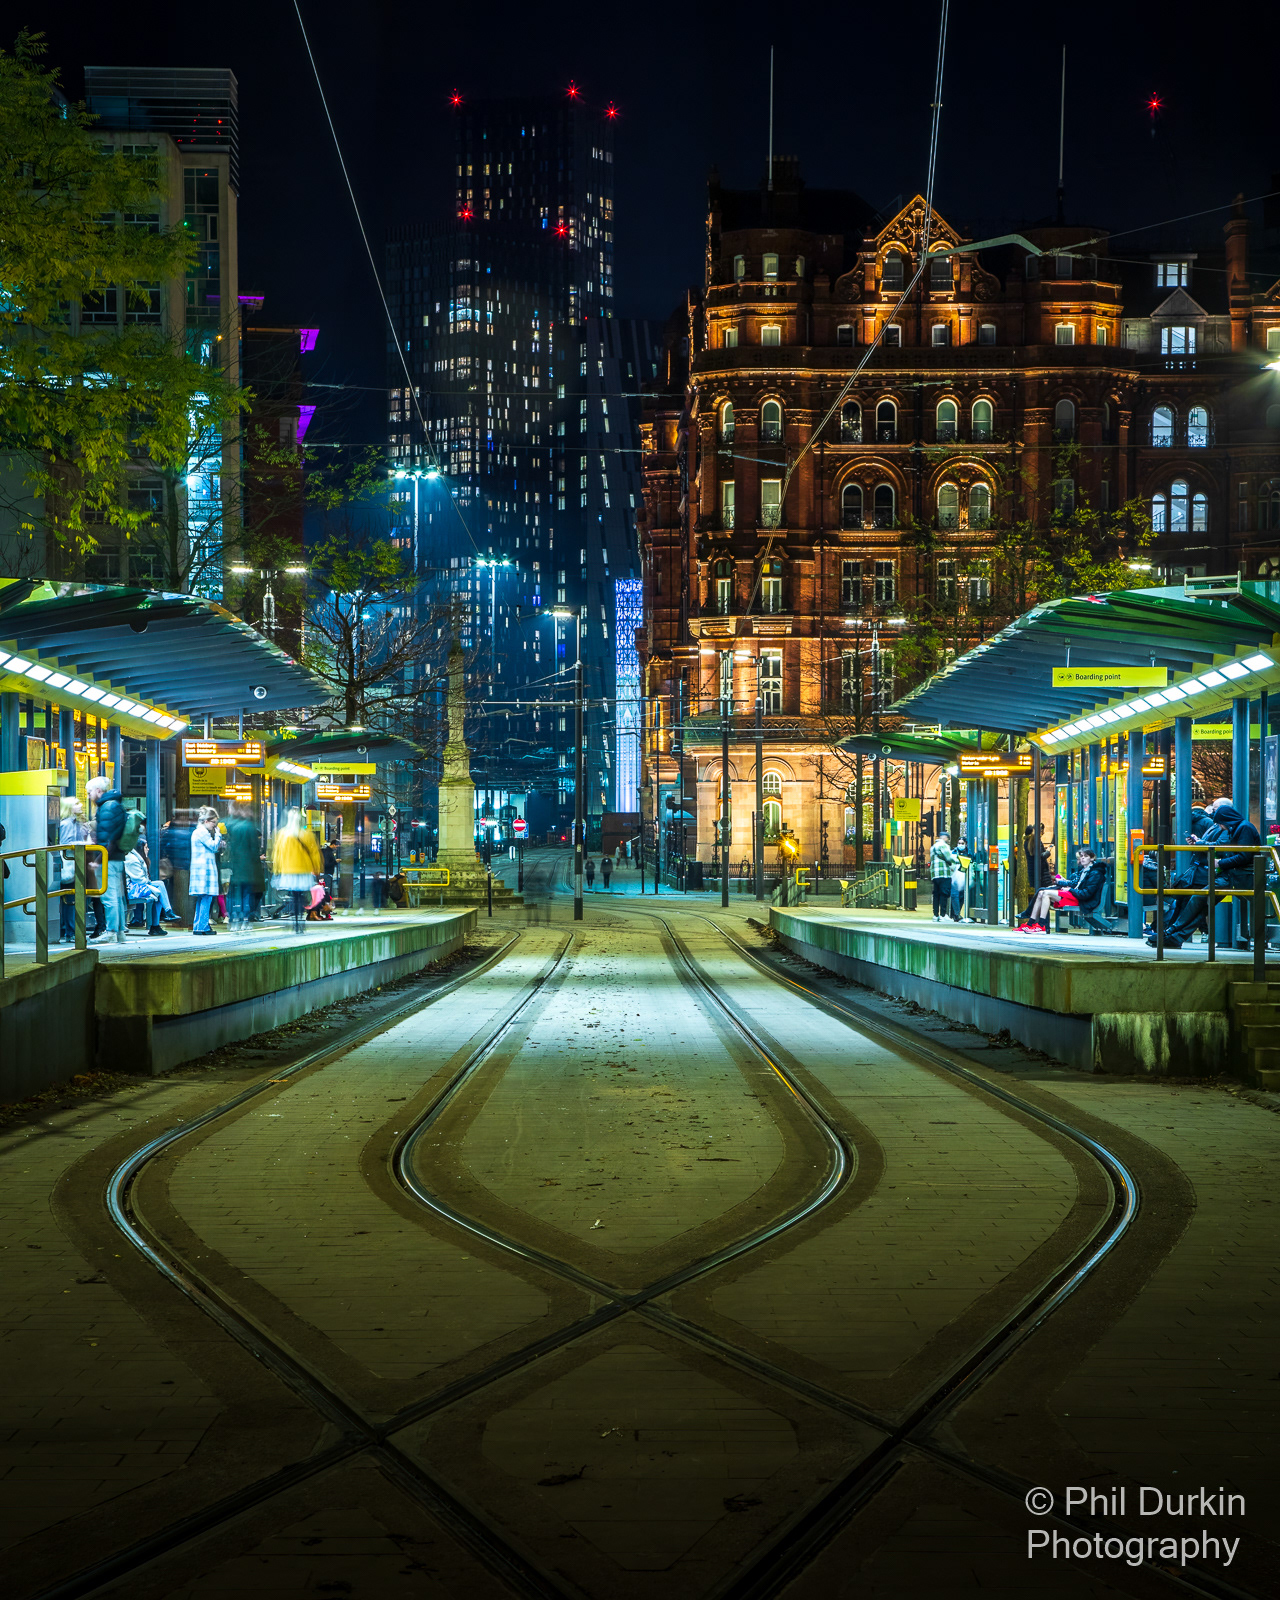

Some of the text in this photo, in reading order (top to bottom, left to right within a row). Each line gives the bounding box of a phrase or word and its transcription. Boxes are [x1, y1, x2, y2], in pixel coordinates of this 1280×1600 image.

[1075, 673, 1121, 682] Boarding point
[1200, 728, 1222, 736] Boarding
